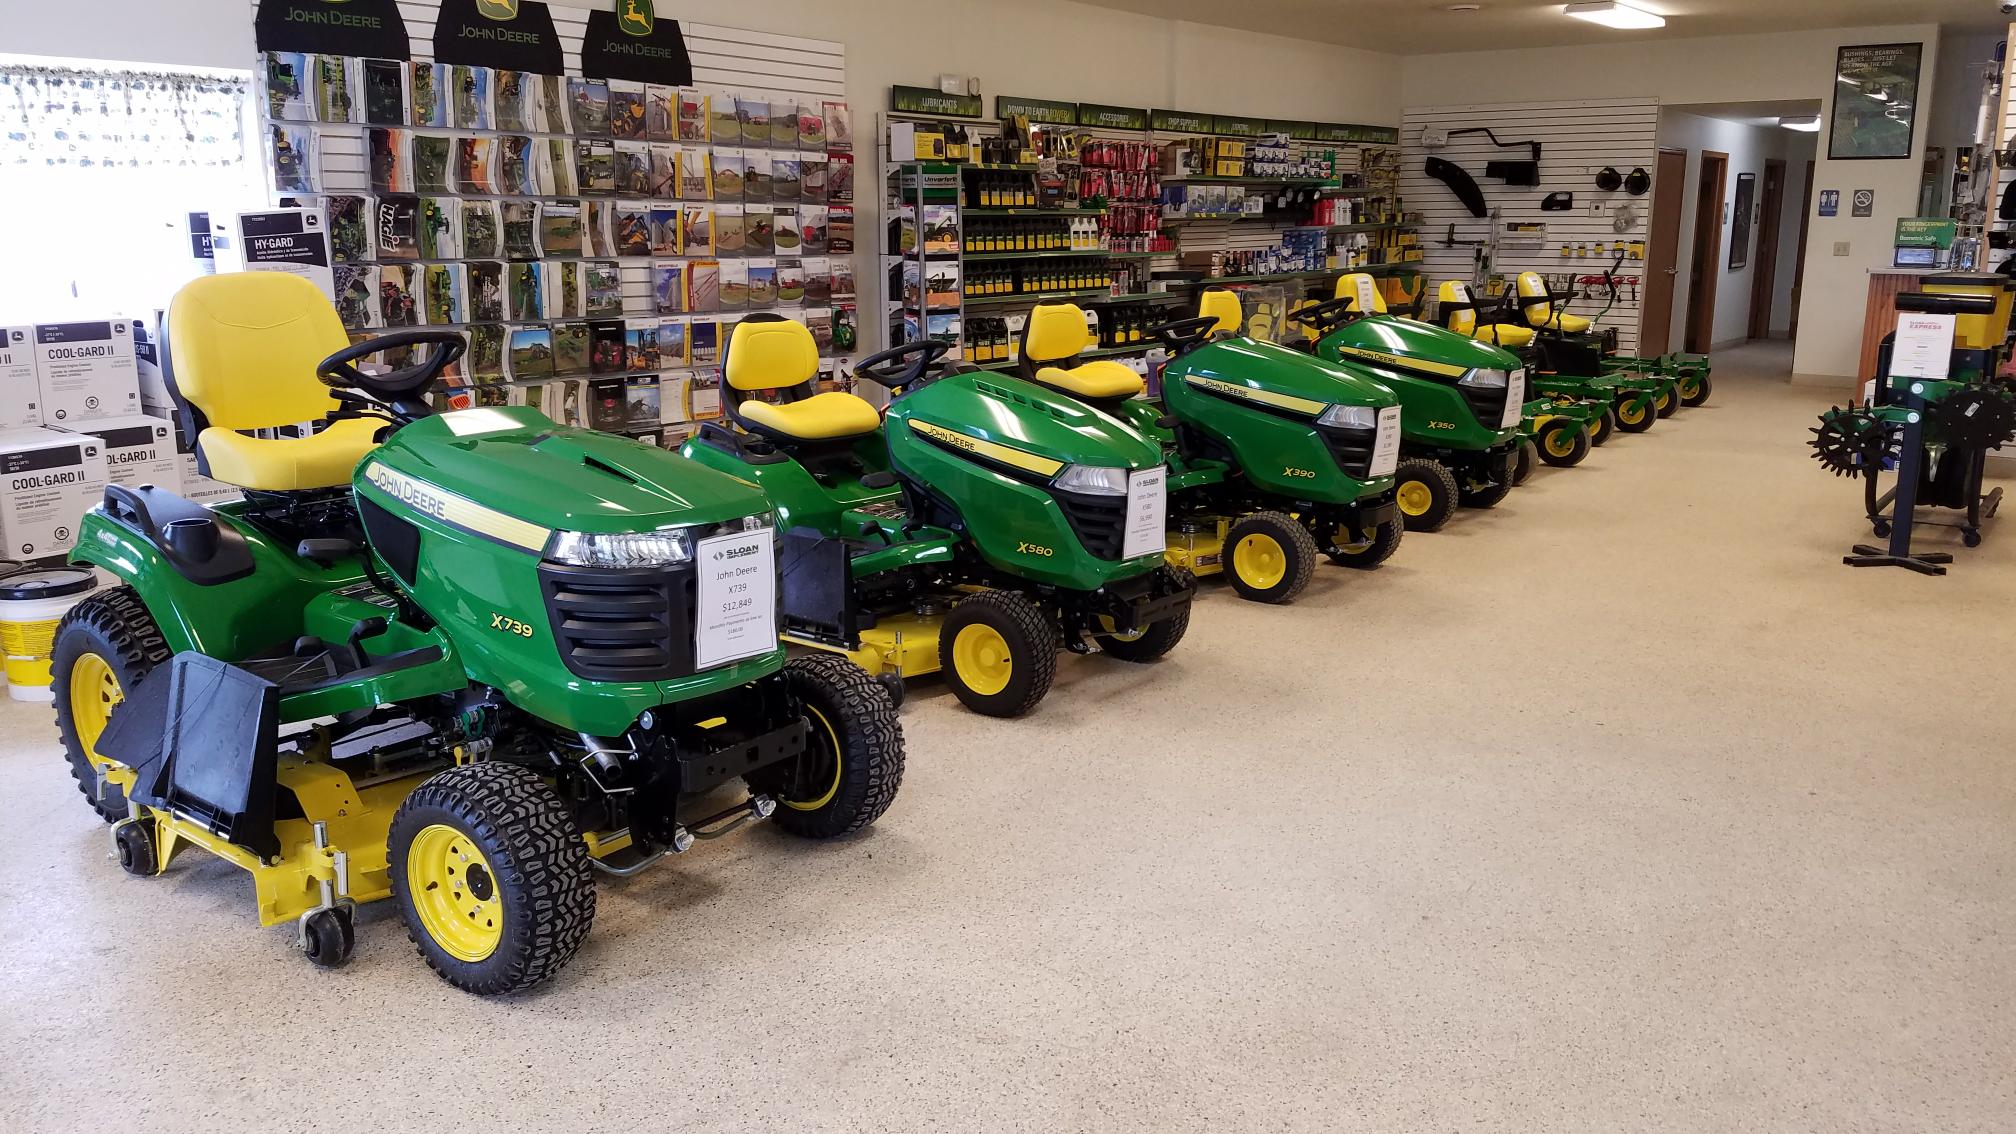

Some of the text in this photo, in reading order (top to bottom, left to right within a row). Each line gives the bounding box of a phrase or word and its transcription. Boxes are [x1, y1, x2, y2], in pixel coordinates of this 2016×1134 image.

[284, 6, 381, 28] JOHN DEERE
[458, 24, 540, 44] JOHN DEERE
[602, 40, 672, 59] JOHN DEERE
[922, 98, 958, 109] LUBRICANTS
[1008, 104, 1024, 114] DOWN
[1026, 106, 1032, 114] TO
[1033, 107, 1049, 116] EARTH
[1100, 112, 1130, 123] ACCESSORIES
[1168, 117, 1199, 128] SHOP SUPPLIES
[380, 204, 396, 251] HAGIE
[255, 238, 294, 249] HY-GARD
[4, 354, 11, 364] II
[48, 345, 114, 360] COOL-GARD II
[1358, 350, 1396, 364] JOHN DEERE
[1205, 380, 1248, 398] JOHN DEERE
[1428, 420, 1456, 430] X350
[928, 426, 976, 450] JOHN DEERE
[149, 450, 156, 460] II
[1282, 466, 1316, 478] X390
[12, 470, 85, 490] COOL-GARD II
[374, 467, 445, 517] JOHN DEERE
[726, 544, 759, 556] SLOAN
[727, 550, 759, 560] IMPLEMENT
[1016, 542, 1052, 556] X580
[716, 565, 758, 580] John Deere
[728, 583, 747, 594] X739
[491, 612, 533, 638] X739
